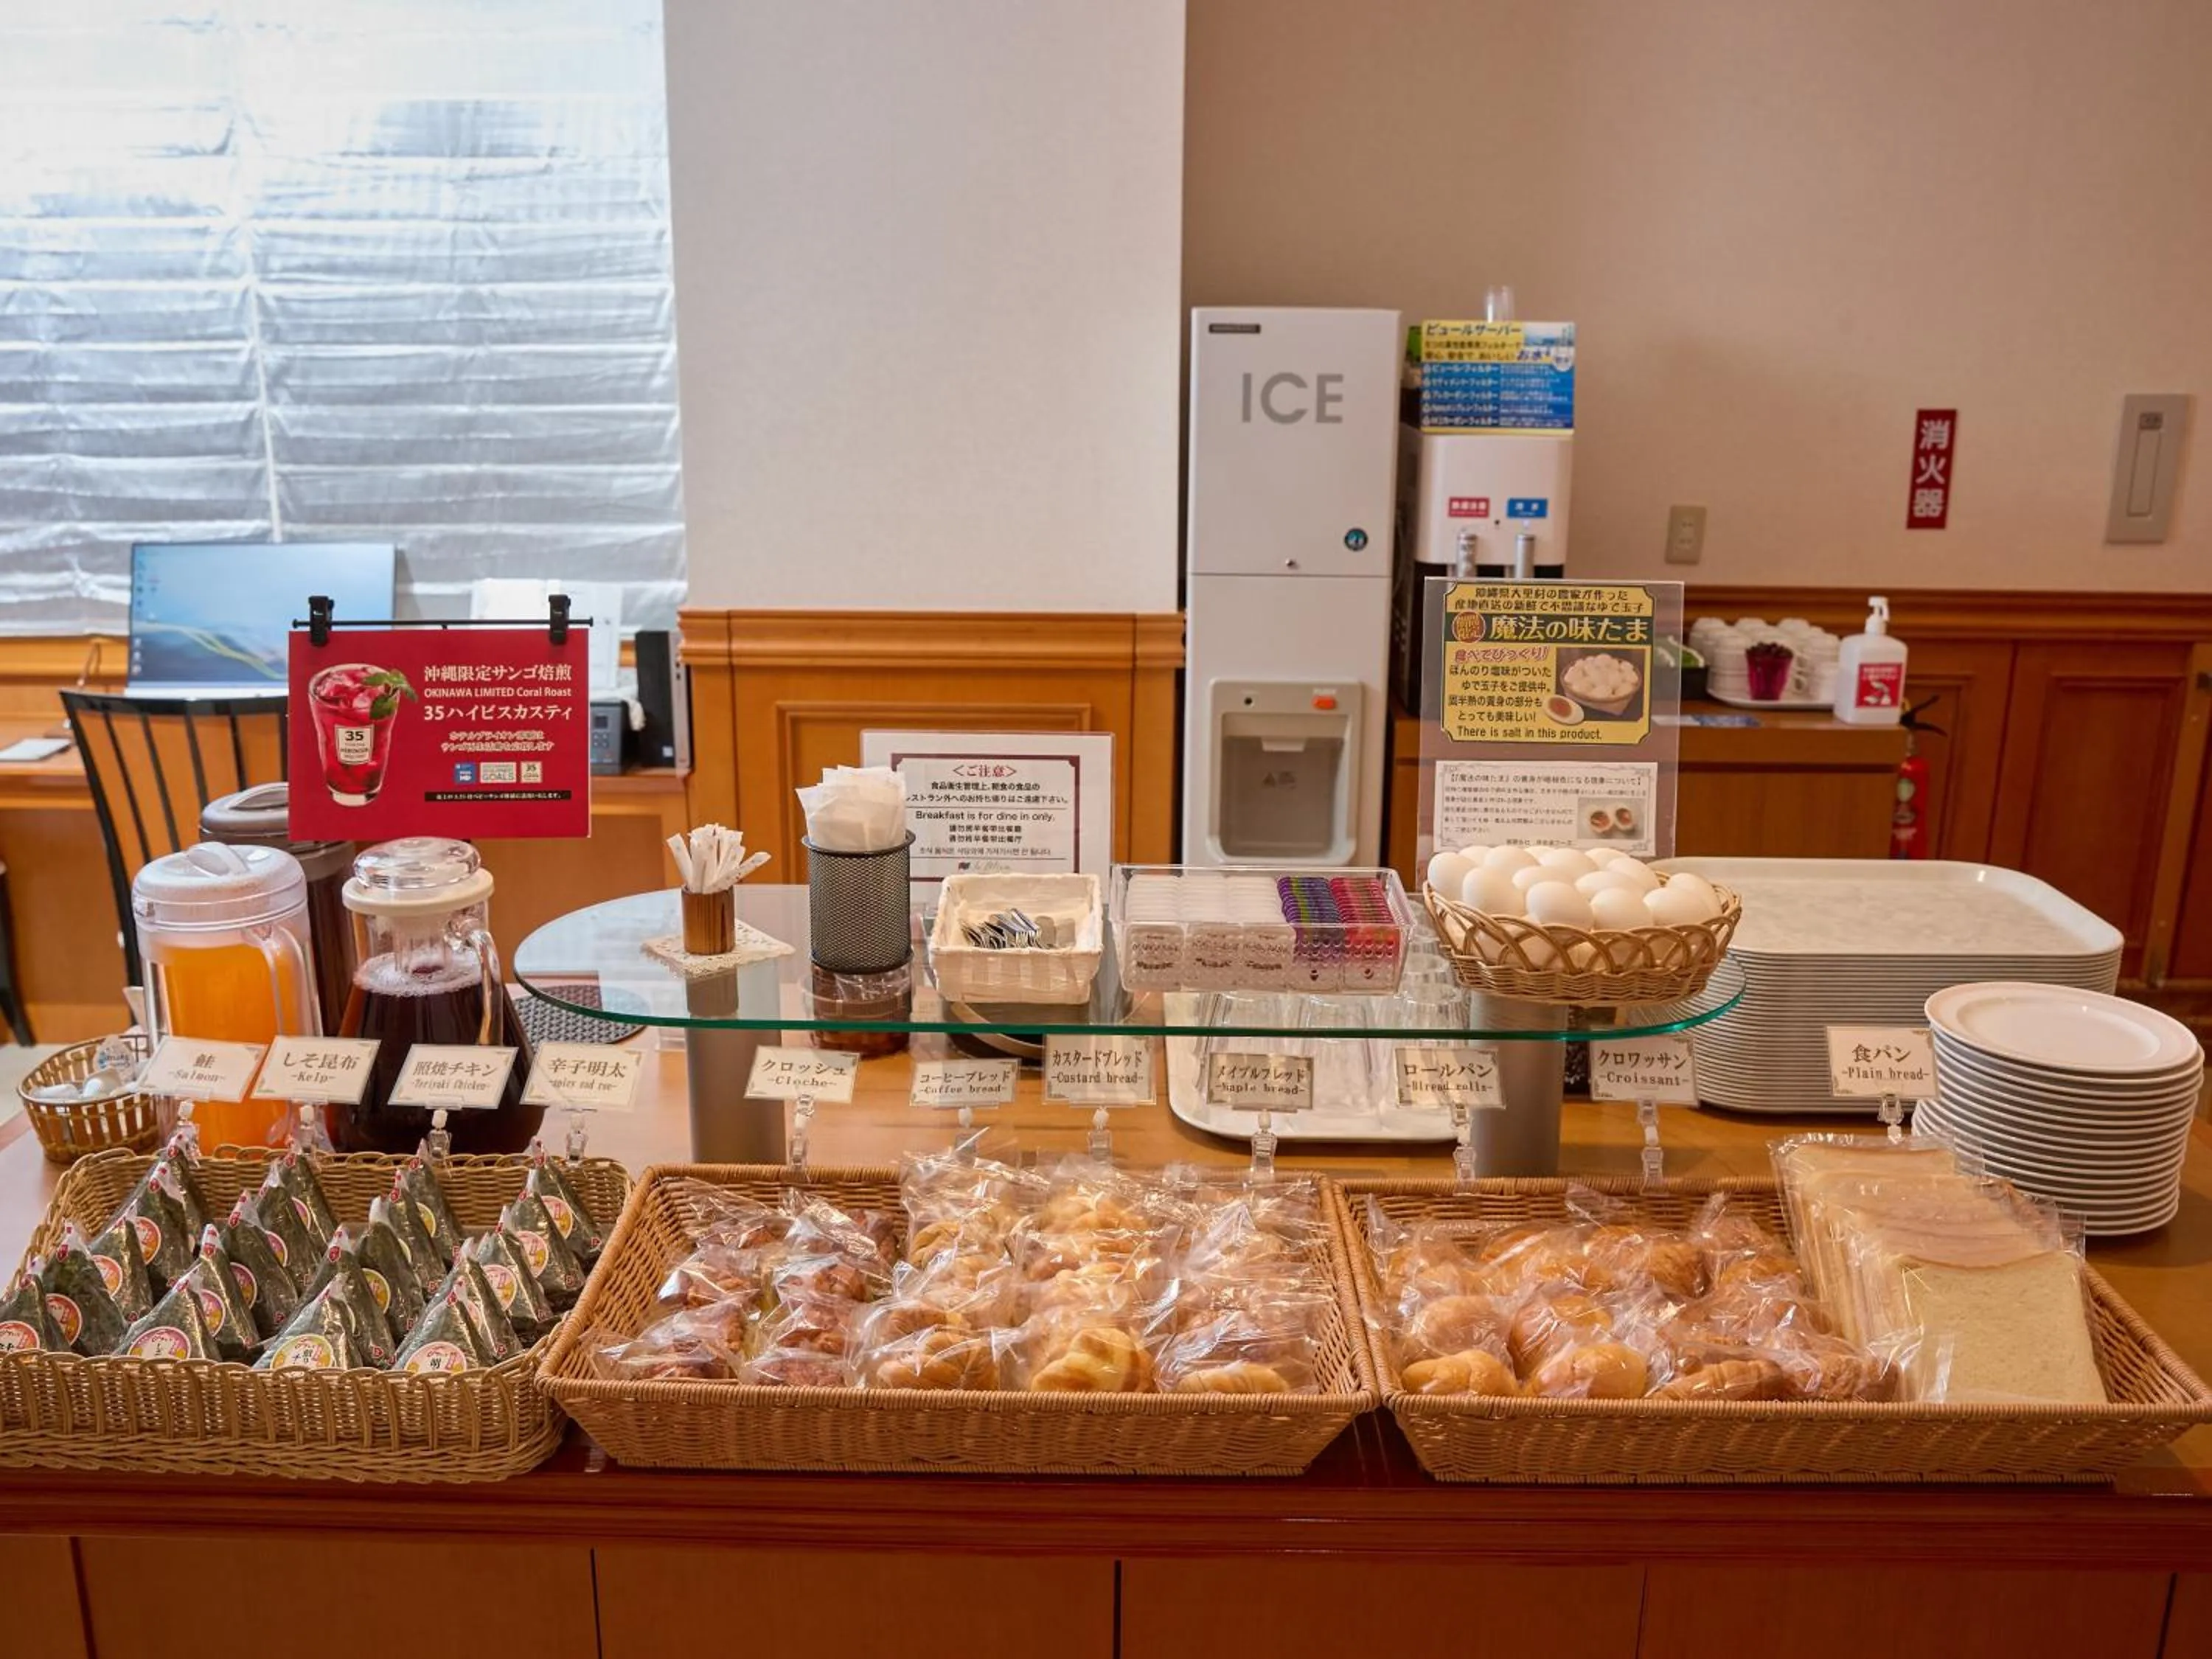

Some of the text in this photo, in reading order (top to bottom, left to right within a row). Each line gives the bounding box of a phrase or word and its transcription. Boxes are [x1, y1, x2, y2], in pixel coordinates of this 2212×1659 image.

[1242, 372, 1343, 425] ICE
[1913, 419, 1951, 518] 消火器
[1489, 615, 1648, 641] 魔法の味たま
[424, 665, 571, 682] 沖縄限定サンゴ焙煎
[424, 687, 571, 698] OKINAWA LIMITED Coral Roast
[345, 731, 364, 741] 35
[1457, 726, 1486, 737] There
[1490, 726, 1498, 737] is
[1503, 727, 1521, 737] salt
[1525, 728, 1534, 737] in
[1537, 728, 1557, 738] this
[915, 811, 964, 820] Breakfast
[967, 812, 975, 820] is
[978, 812, 994, 820] for
[996, 813, 1018, 821] dine
[1020, 813, 1030, 821] in
[283, 1052, 361, 1070] しそ昆布
[1052, 1049, 1143, 1068] カスタードブレッド
[1597, 1048, 1688, 1070] クロワッサン
[1851, 1043, 1912, 1062] 食パン
[413, 1061, 498, 1077] 照焼チキン
[548, 1057, 627, 1078] 辛子明太
[1404, 1062, 1492, 1078] ロールパン
